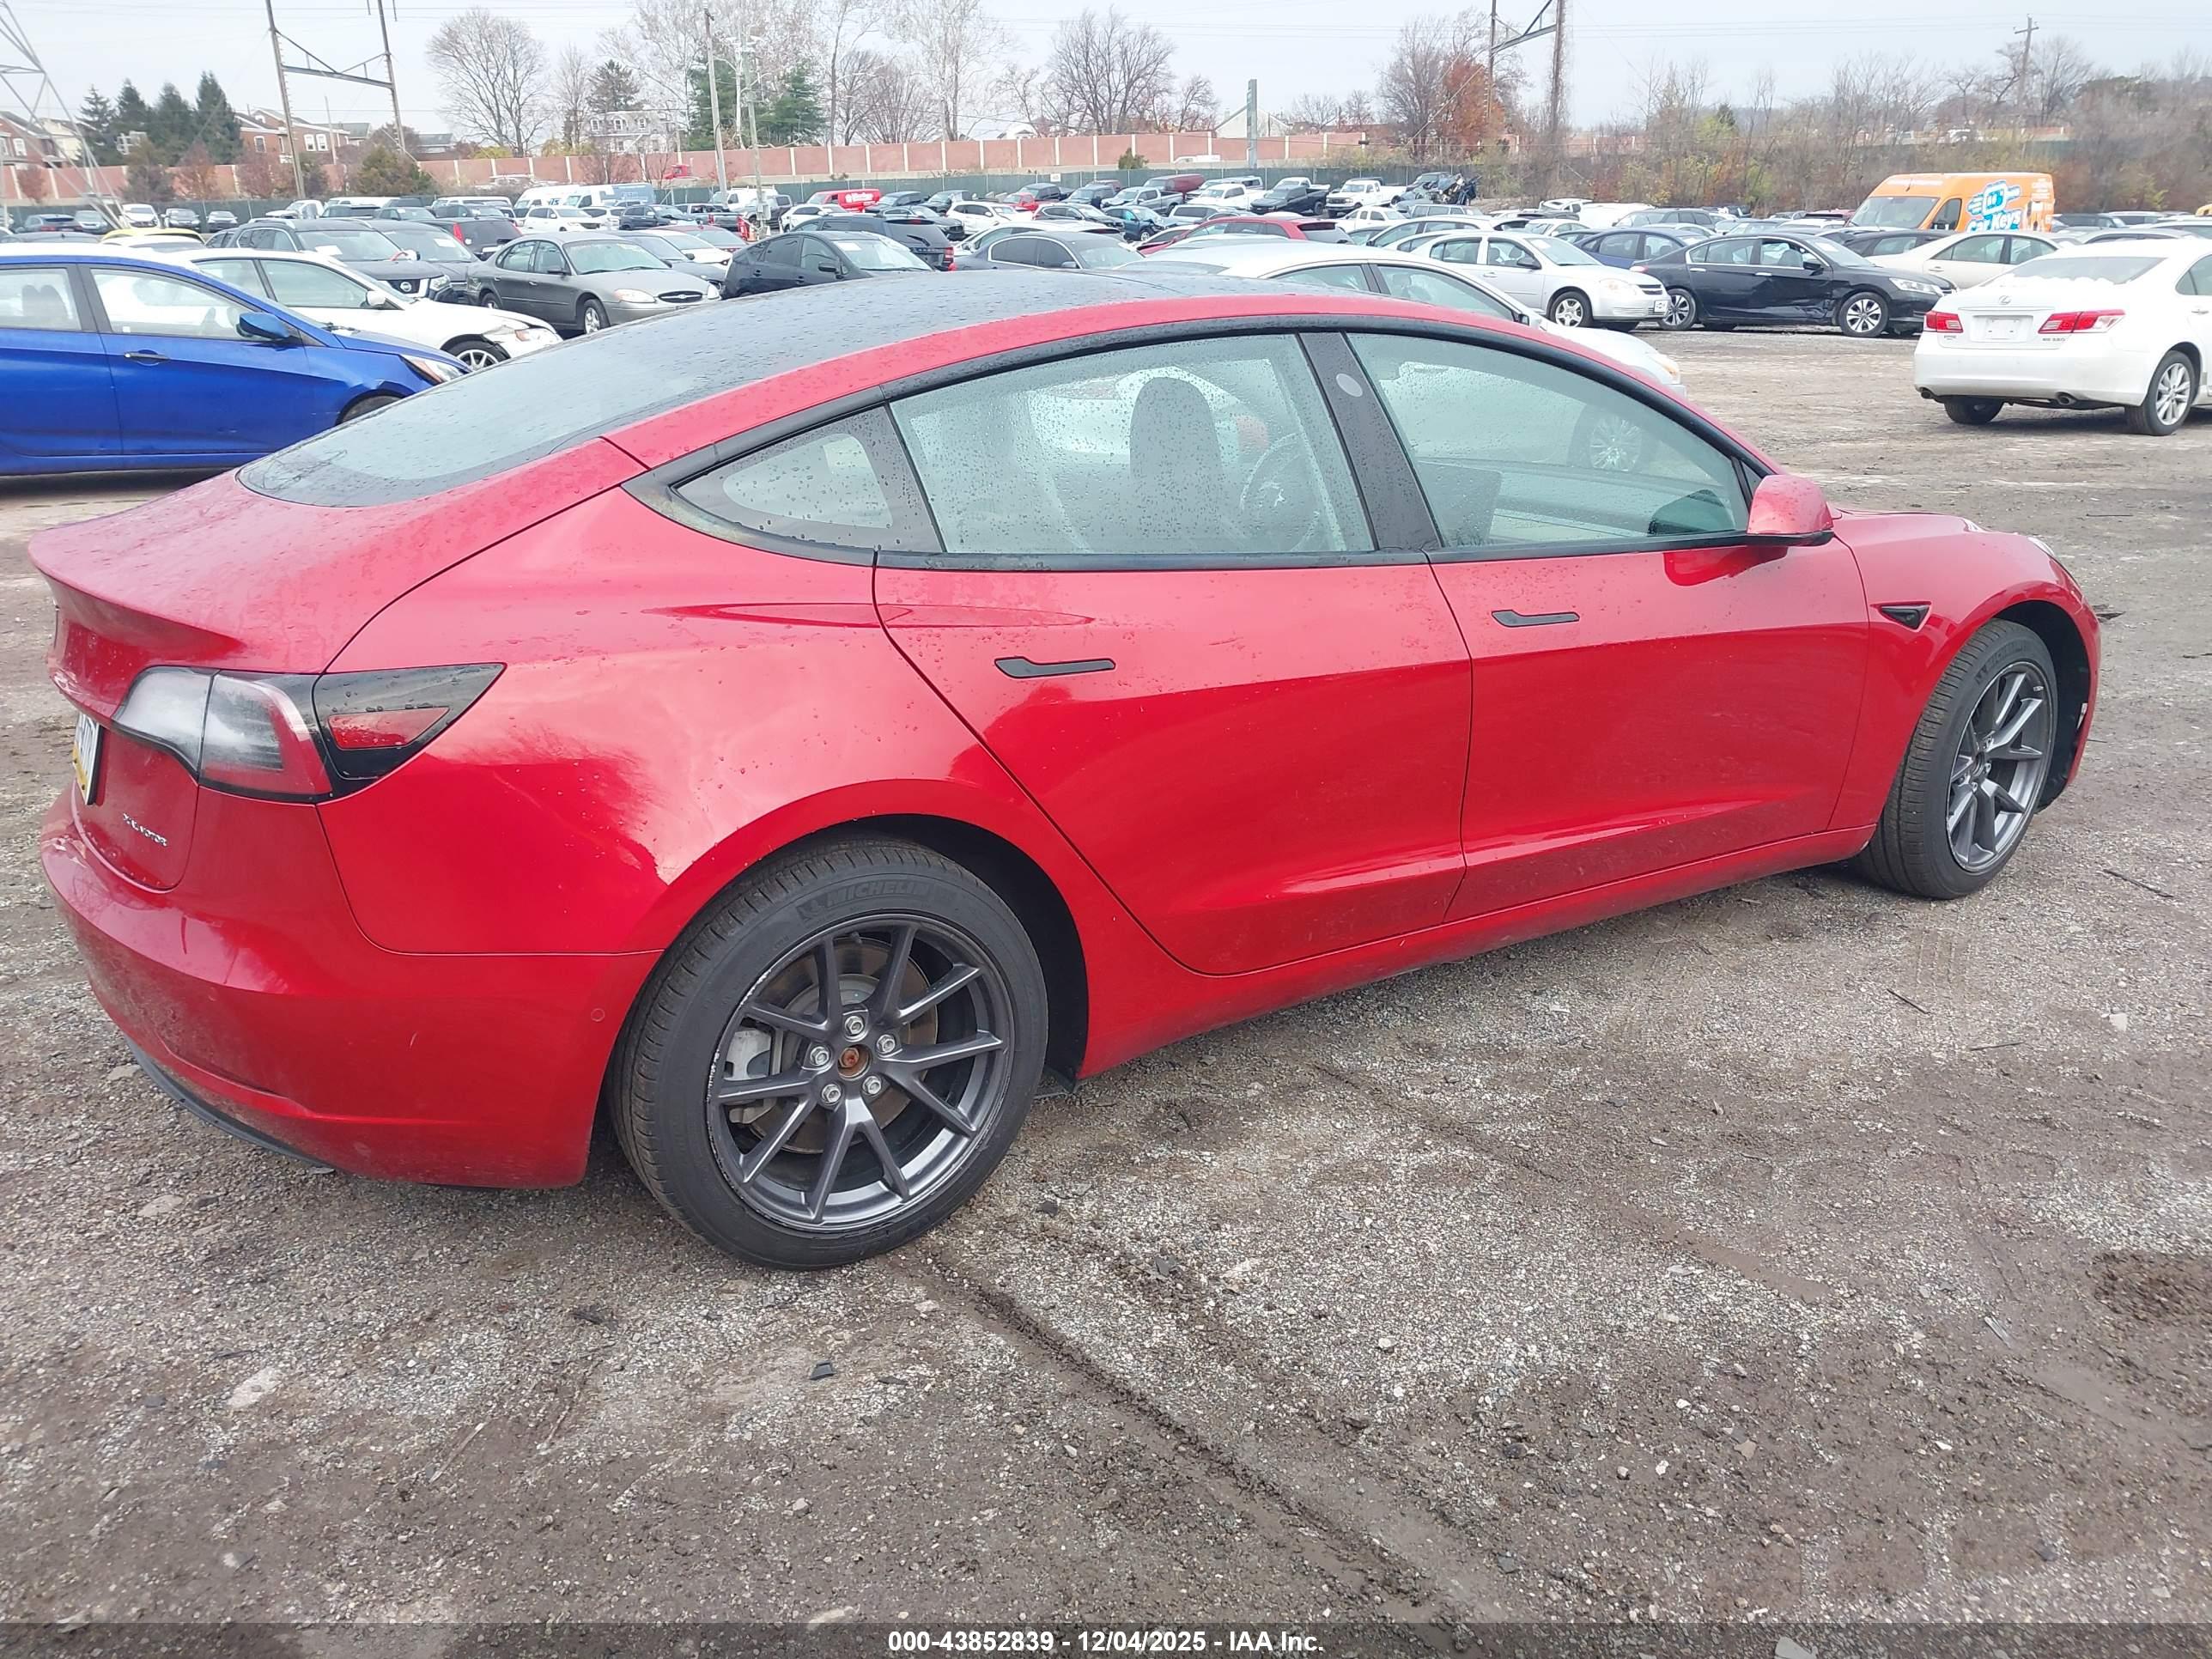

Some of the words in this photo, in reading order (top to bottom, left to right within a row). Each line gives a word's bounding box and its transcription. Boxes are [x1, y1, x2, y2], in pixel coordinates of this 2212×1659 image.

[1966, 217, 1991, 233] Car
[1992, 210, 2021, 230] Keys
[825, 879, 931, 908] MICHELIN
